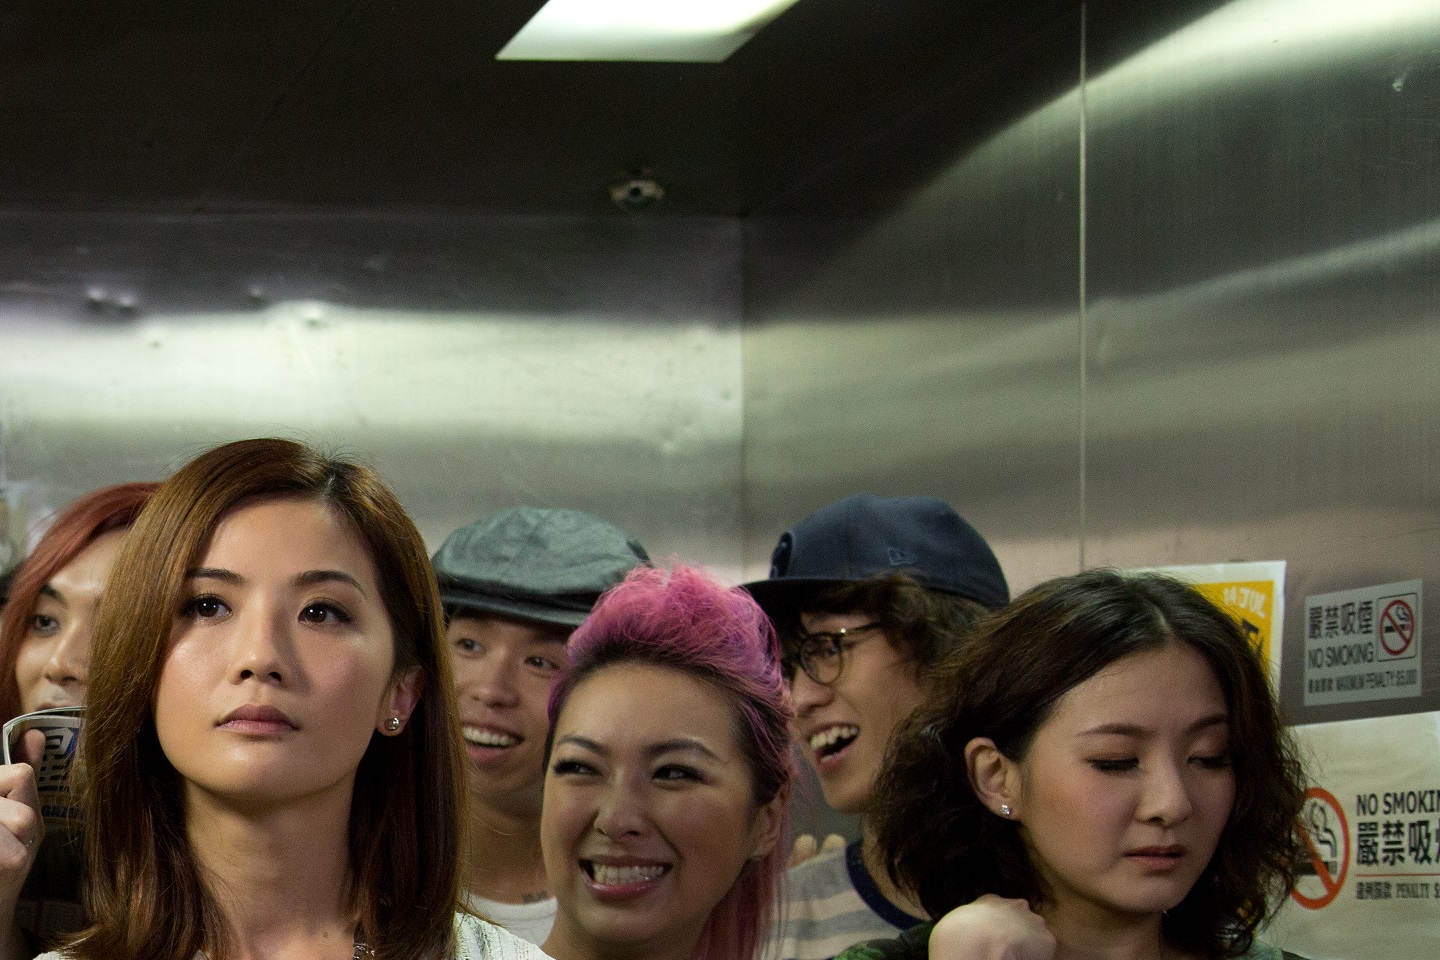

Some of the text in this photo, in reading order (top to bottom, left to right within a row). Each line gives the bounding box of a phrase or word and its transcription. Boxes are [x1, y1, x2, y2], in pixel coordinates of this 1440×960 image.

[1308, 642, 1374, 668] NO SMOKING
[1357, 794, 1378, 815] NO
